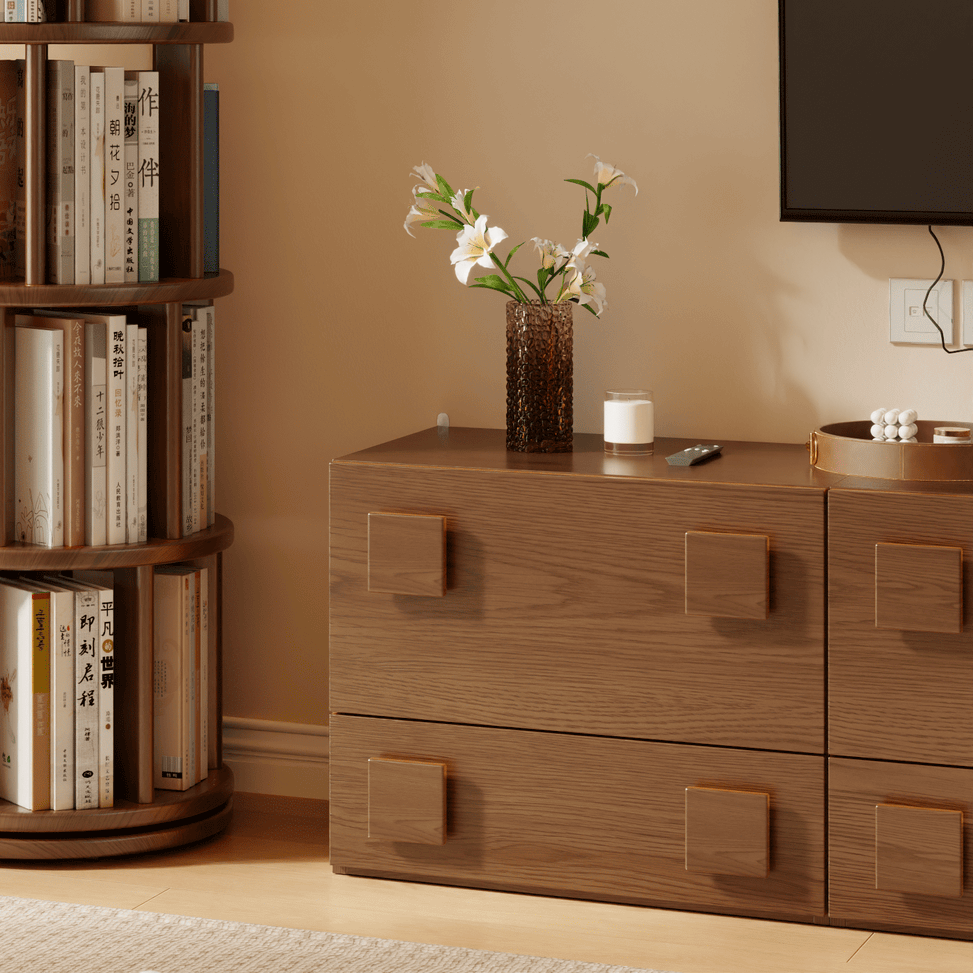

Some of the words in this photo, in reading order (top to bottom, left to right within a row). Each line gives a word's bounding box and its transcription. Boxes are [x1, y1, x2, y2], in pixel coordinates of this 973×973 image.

[109, 119, 121, 211] 朝花夕拾
[126, 207, 134, 273] 中国文学出版社
[112, 330, 124, 380] 晚秋拾叶
[114, 388, 122, 418] 回忆录
[77, 614, 96, 708] 即刻启程
[100, 601, 114, 690] 平凡的世界
